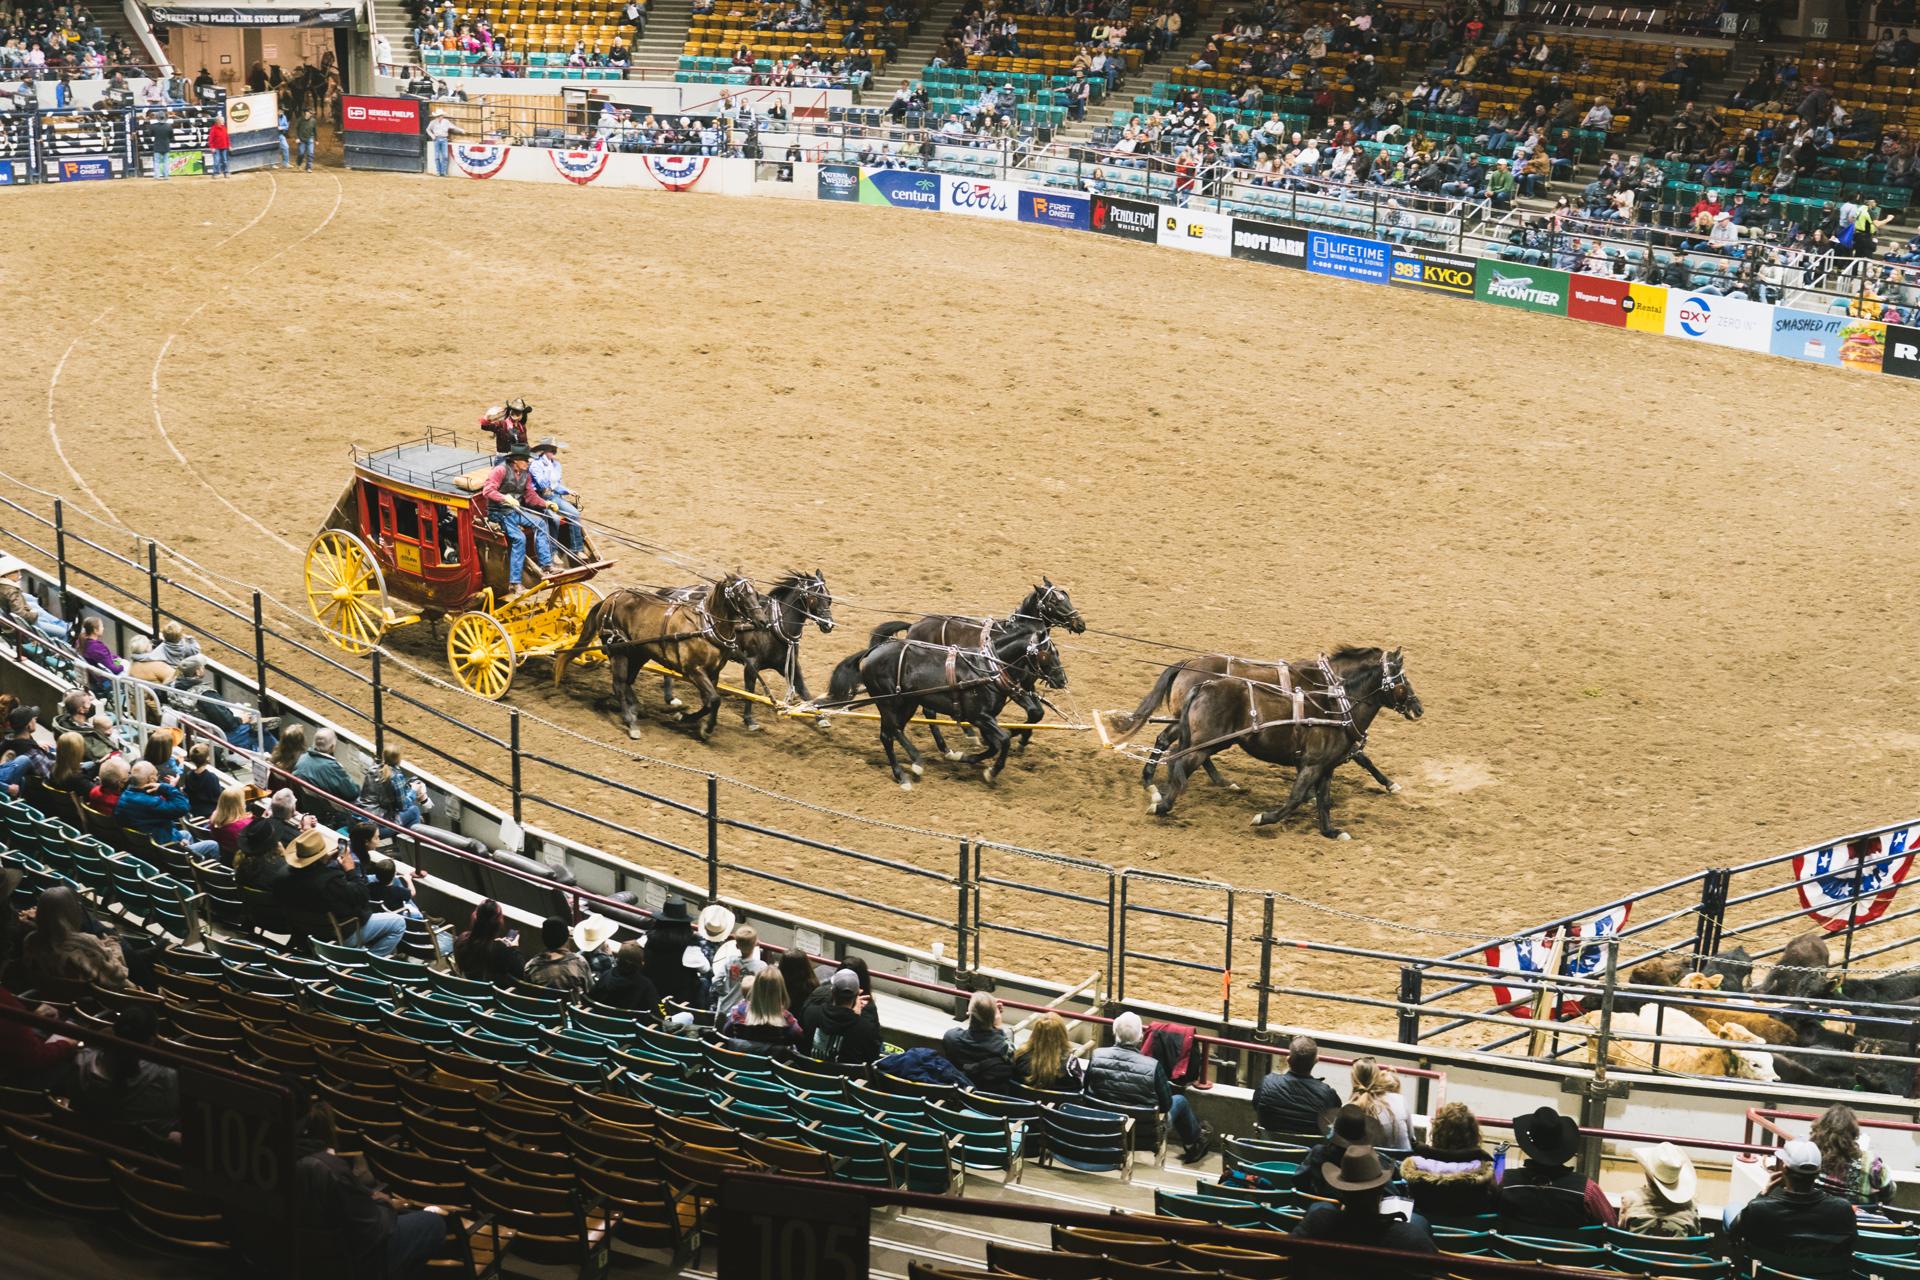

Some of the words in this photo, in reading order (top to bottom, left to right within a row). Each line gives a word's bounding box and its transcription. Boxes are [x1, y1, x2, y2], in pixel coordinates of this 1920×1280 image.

[211, 15, 234, 23] PLACE
[236, 15, 253, 23] LIKE
[254, 15, 279, 23] STOCK
[280, 15, 300, 23] SHOW
[1814, 21, 1828, 35] 127
[368, 109, 392, 117] HENSEL
[892, 190, 935, 203] centura
[952, 181, 1007, 211] Coors
[1049, 202, 1072, 212] FIRST
[1049, 210, 1075, 220] ONSITE
[1110, 205, 1155, 229] PENDLETON
[1118, 223, 1145, 233] WHISKY
[1234, 231, 1269, 251] BOOT
[1269, 236, 1305, 257] BARN
[1330, 242, 1384, 261] LIFETIME
[1330, 253, 1357, 263] WINDOWS
[1364, 259, 1384, 267] SIDING
[1450, 260, 1476, 268] COUNTRY
[1313, 260, 1331, 269] 1-800
[1350, 267, 1382, 277] WINDOWS
[1424, 265, 1472, 286] KYGO
[1487, 282, 1559, 306] FRONTIER
[1575, 291, 1599, 302] Wagner
[1600, 295, 1617, 305] Rents
[1636, 302, 1662, 313] Rental
[1680, 310, 1711, 323] OXY
[1717, 316, 1740, 330] ZERO
[1776, 319, 1822, 332] SMASHED
[1825, 321, 1841, 333] IT!
[1894, 342, 1920, 361] R
[197, 1101, 278, 1190] 106
[752, 1215, 857, 1280] 105
